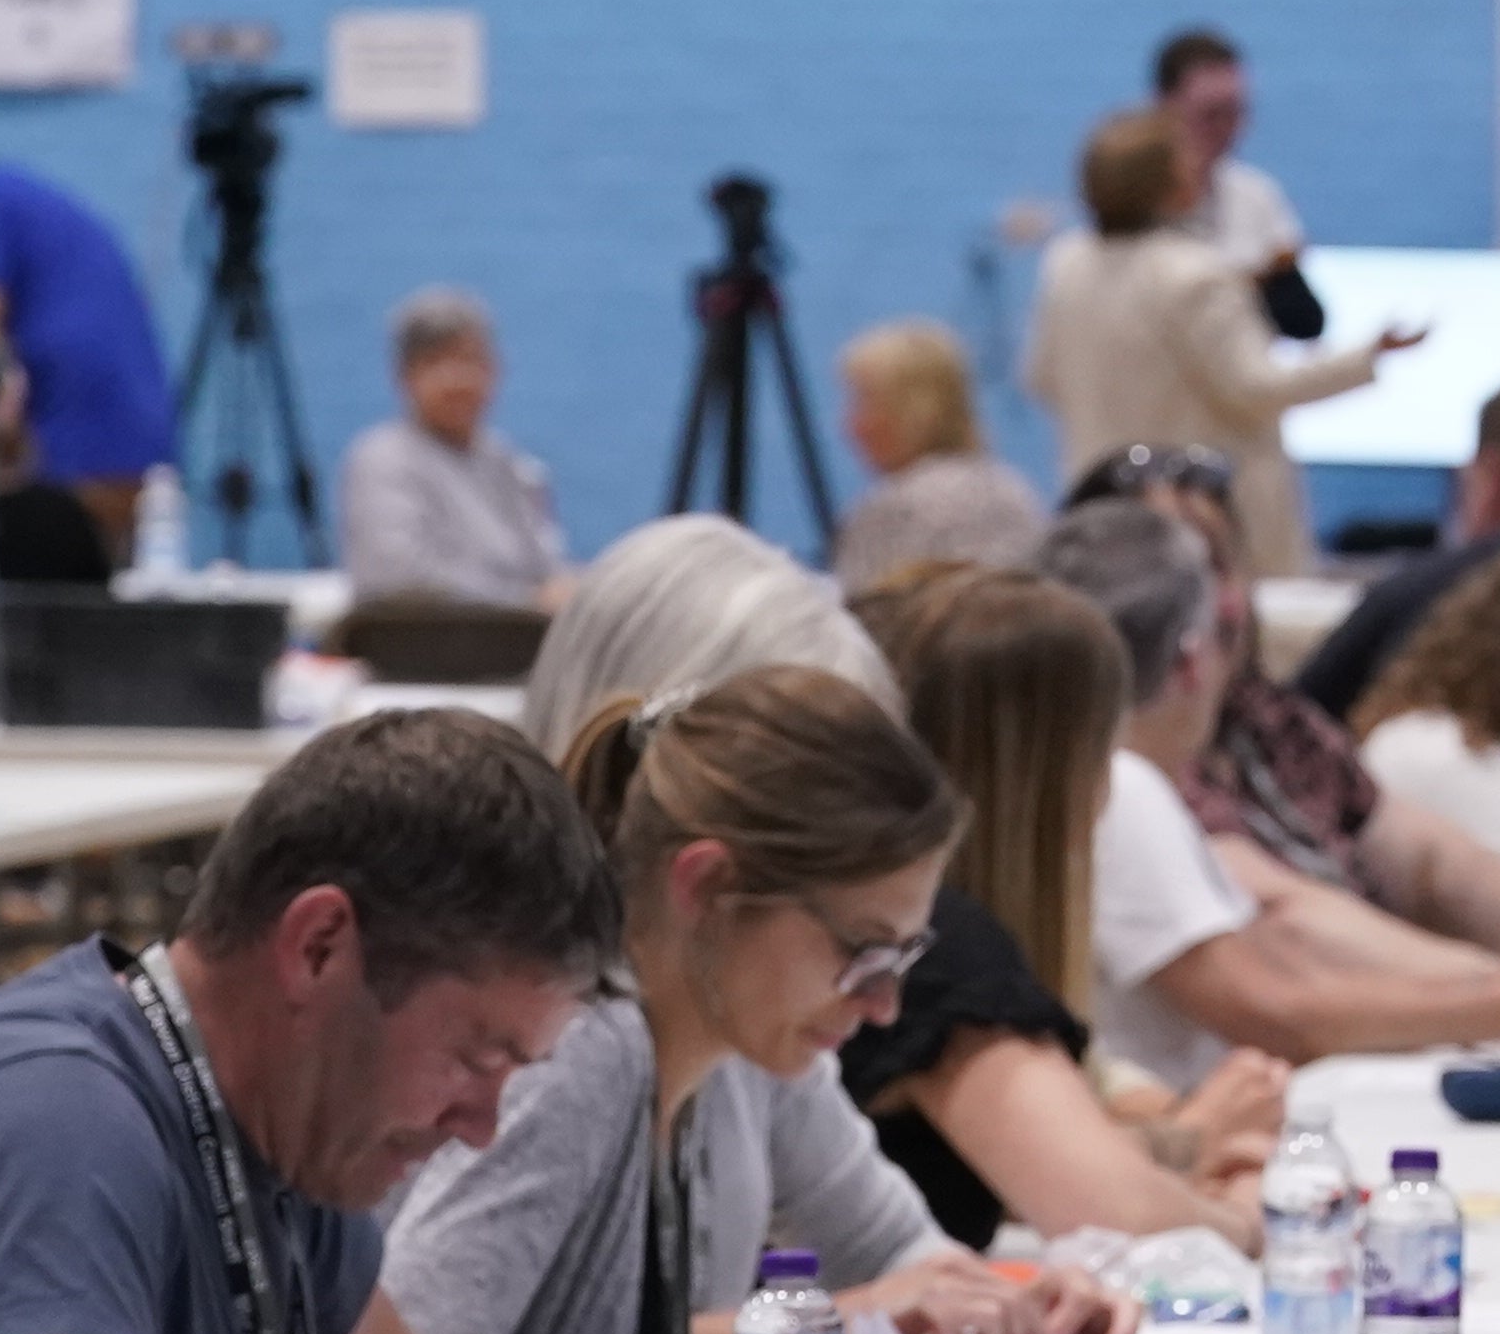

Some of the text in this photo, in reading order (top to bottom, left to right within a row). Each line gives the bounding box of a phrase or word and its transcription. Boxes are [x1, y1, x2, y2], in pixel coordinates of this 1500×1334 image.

[144, 1001, 181, 1063] Devon
[172, 1062, 211, 1134] District
[197, 1134, 229, 1214] Council
